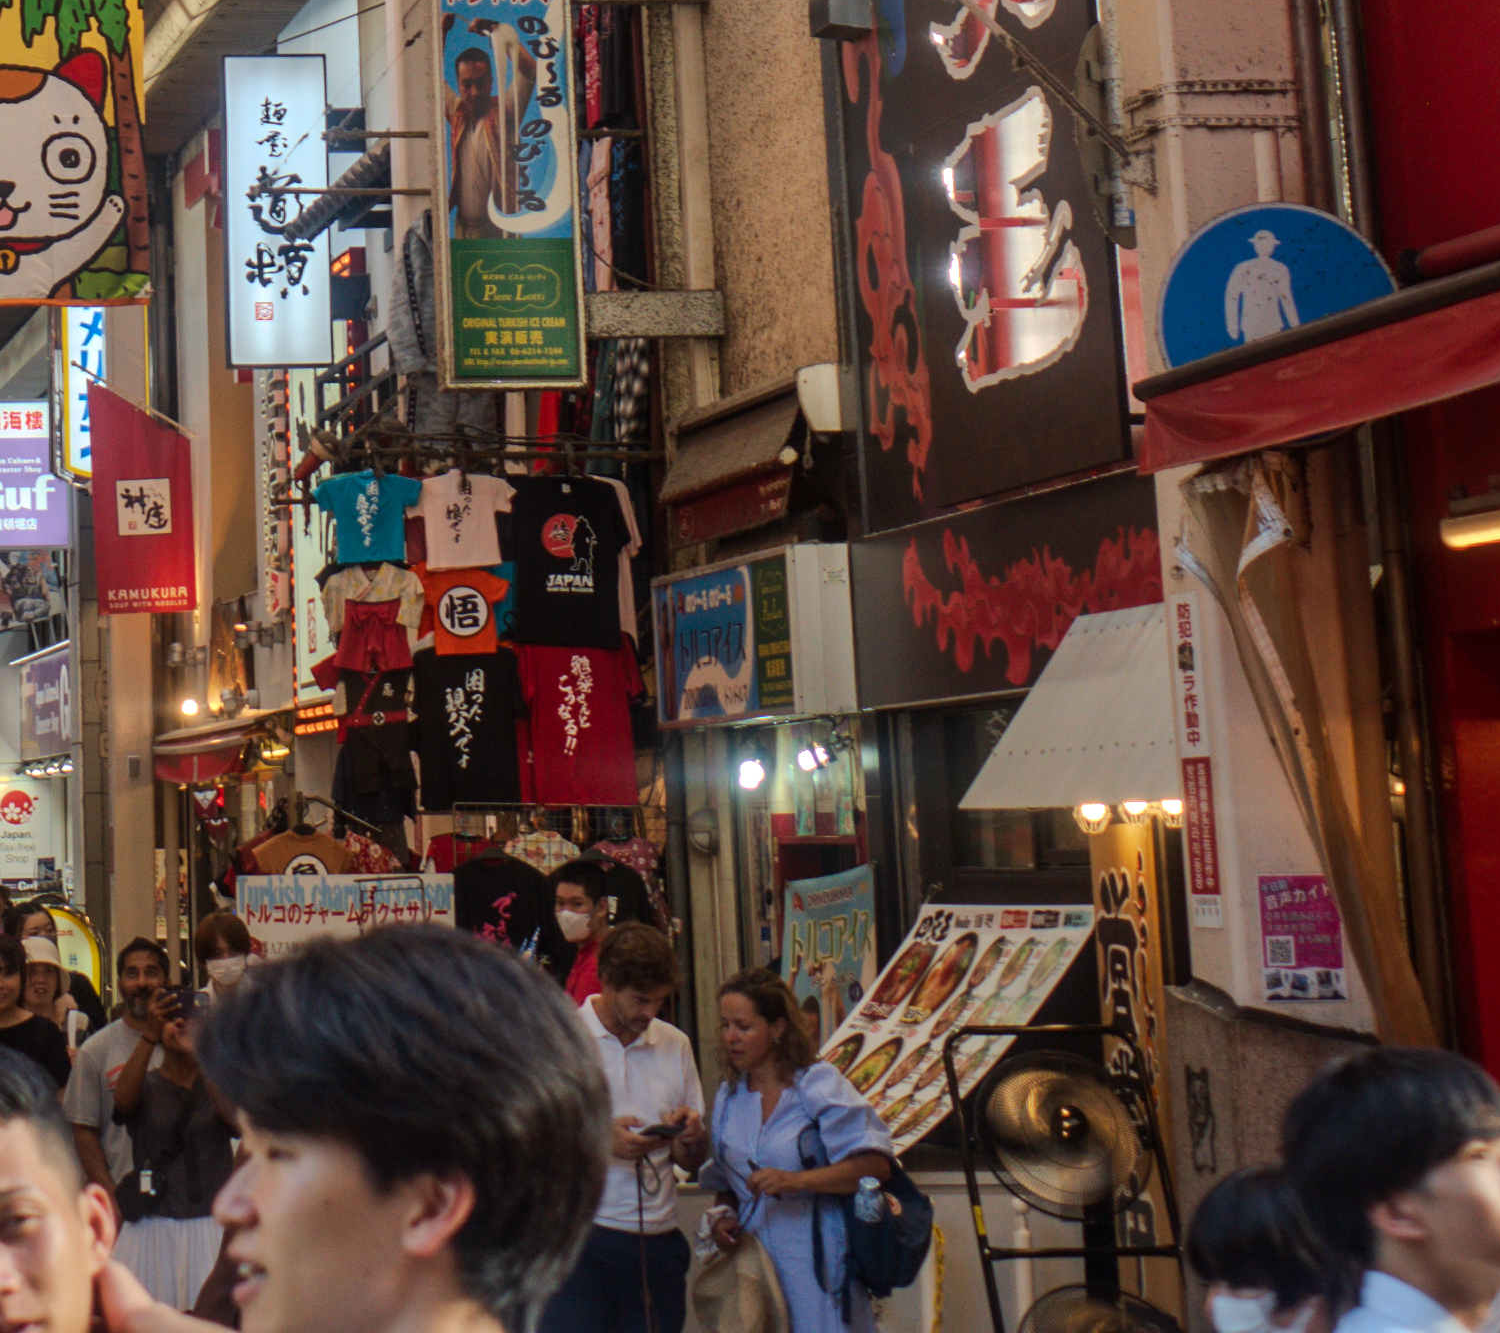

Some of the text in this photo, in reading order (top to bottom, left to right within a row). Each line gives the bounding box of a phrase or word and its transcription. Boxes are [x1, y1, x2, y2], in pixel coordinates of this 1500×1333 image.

[463, 317, 498, 328] ORIGINAL
[498, 317, 528, 327] TURKISH
[485, 331, 543, 345] 実演販売
[24, 465, 42, 474] Shop
[107, 585, 188, 601] KAMUKURA
[546, 573, 595, 588] JAPAN
[446, 594, 481, 629] 悟
[680, 621, 747, 674] トルコアイス
[1176, 601, 1202, 748] 防犯ラ作動中
[465, 668, 485, 722] 困った
[445, 687, 474, 768] 親父です
[0, 829, 34, 841] Japan.
[5, 853, 30, 865] Shop
[236, 876, 306, 913] Turkish
[789, 907, 872, 974] トルコアイス
